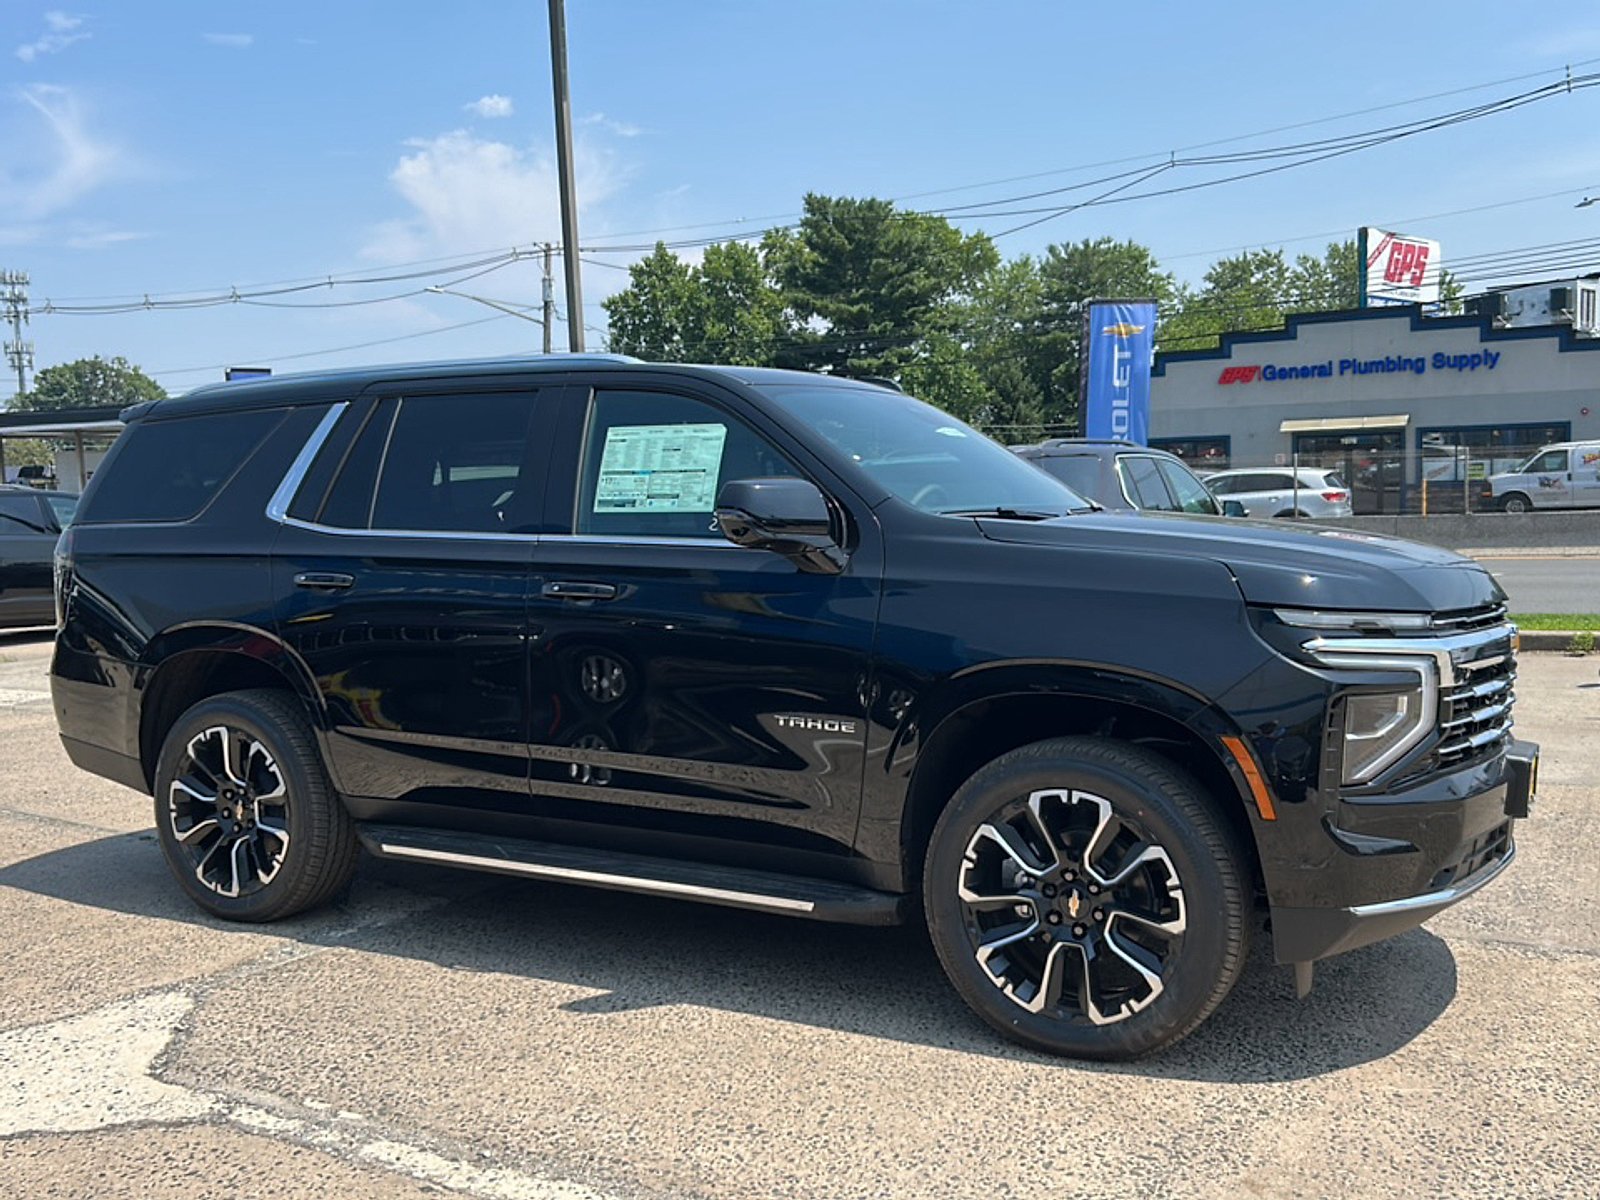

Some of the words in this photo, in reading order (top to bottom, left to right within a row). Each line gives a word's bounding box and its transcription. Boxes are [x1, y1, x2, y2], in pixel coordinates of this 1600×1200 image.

[1384, 241, 1429, 287] GPS
[1218, 365, 1259, 384] GPS
[1263, 360, 1333, 380] General
[1339, 354, 1426, 375] Plumbing
[1432, 348, 1500, 371] Supply
[773, 714, 855, 733] TAHOE
